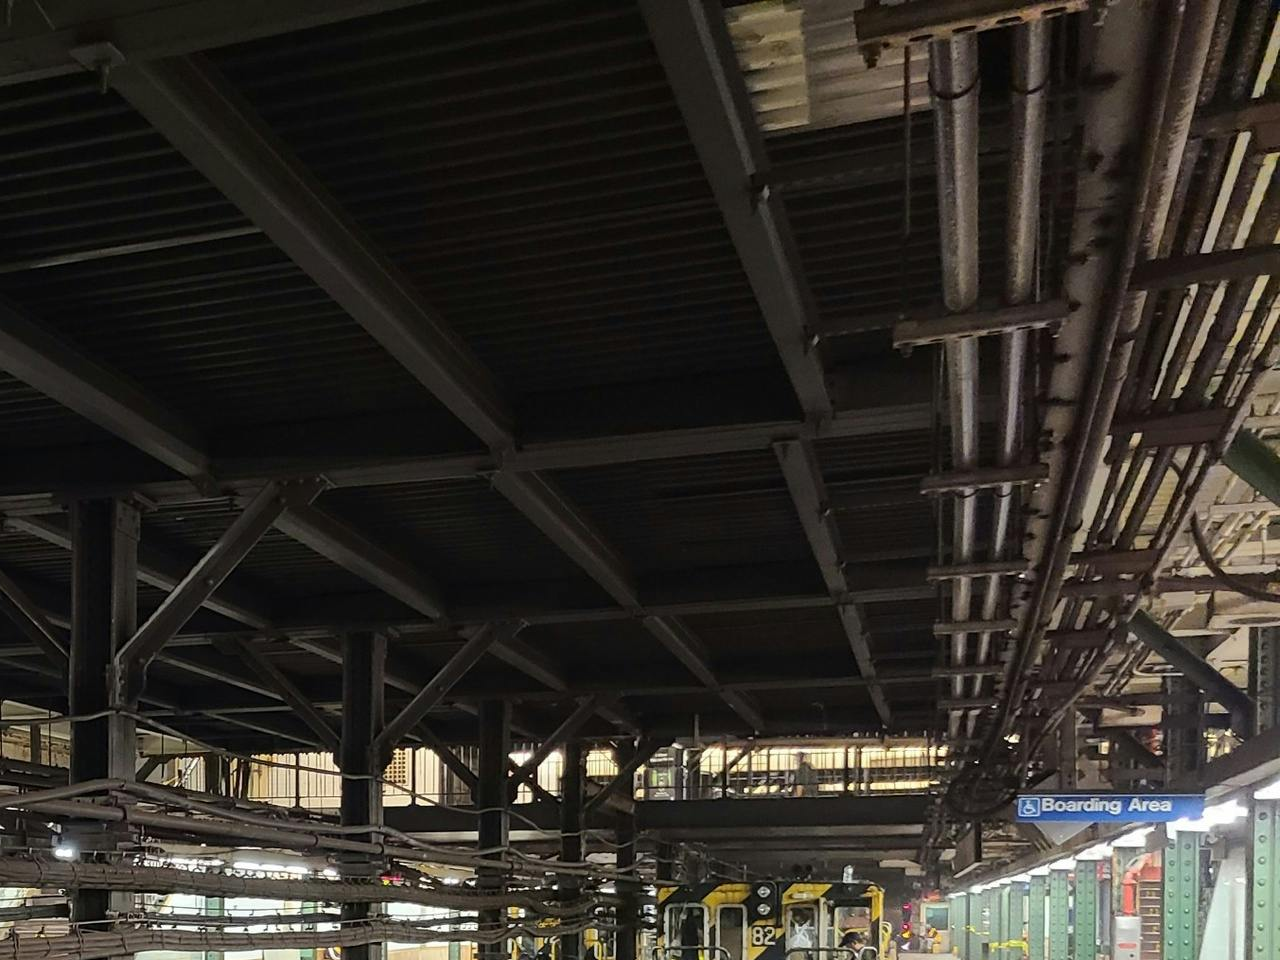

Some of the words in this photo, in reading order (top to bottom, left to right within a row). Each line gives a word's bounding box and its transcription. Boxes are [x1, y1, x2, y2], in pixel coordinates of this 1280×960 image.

[1041, 797, 1122, 815] Boarding
[1127, 797, 1173, 812] Area
[752, 926, 776, 946] 82
